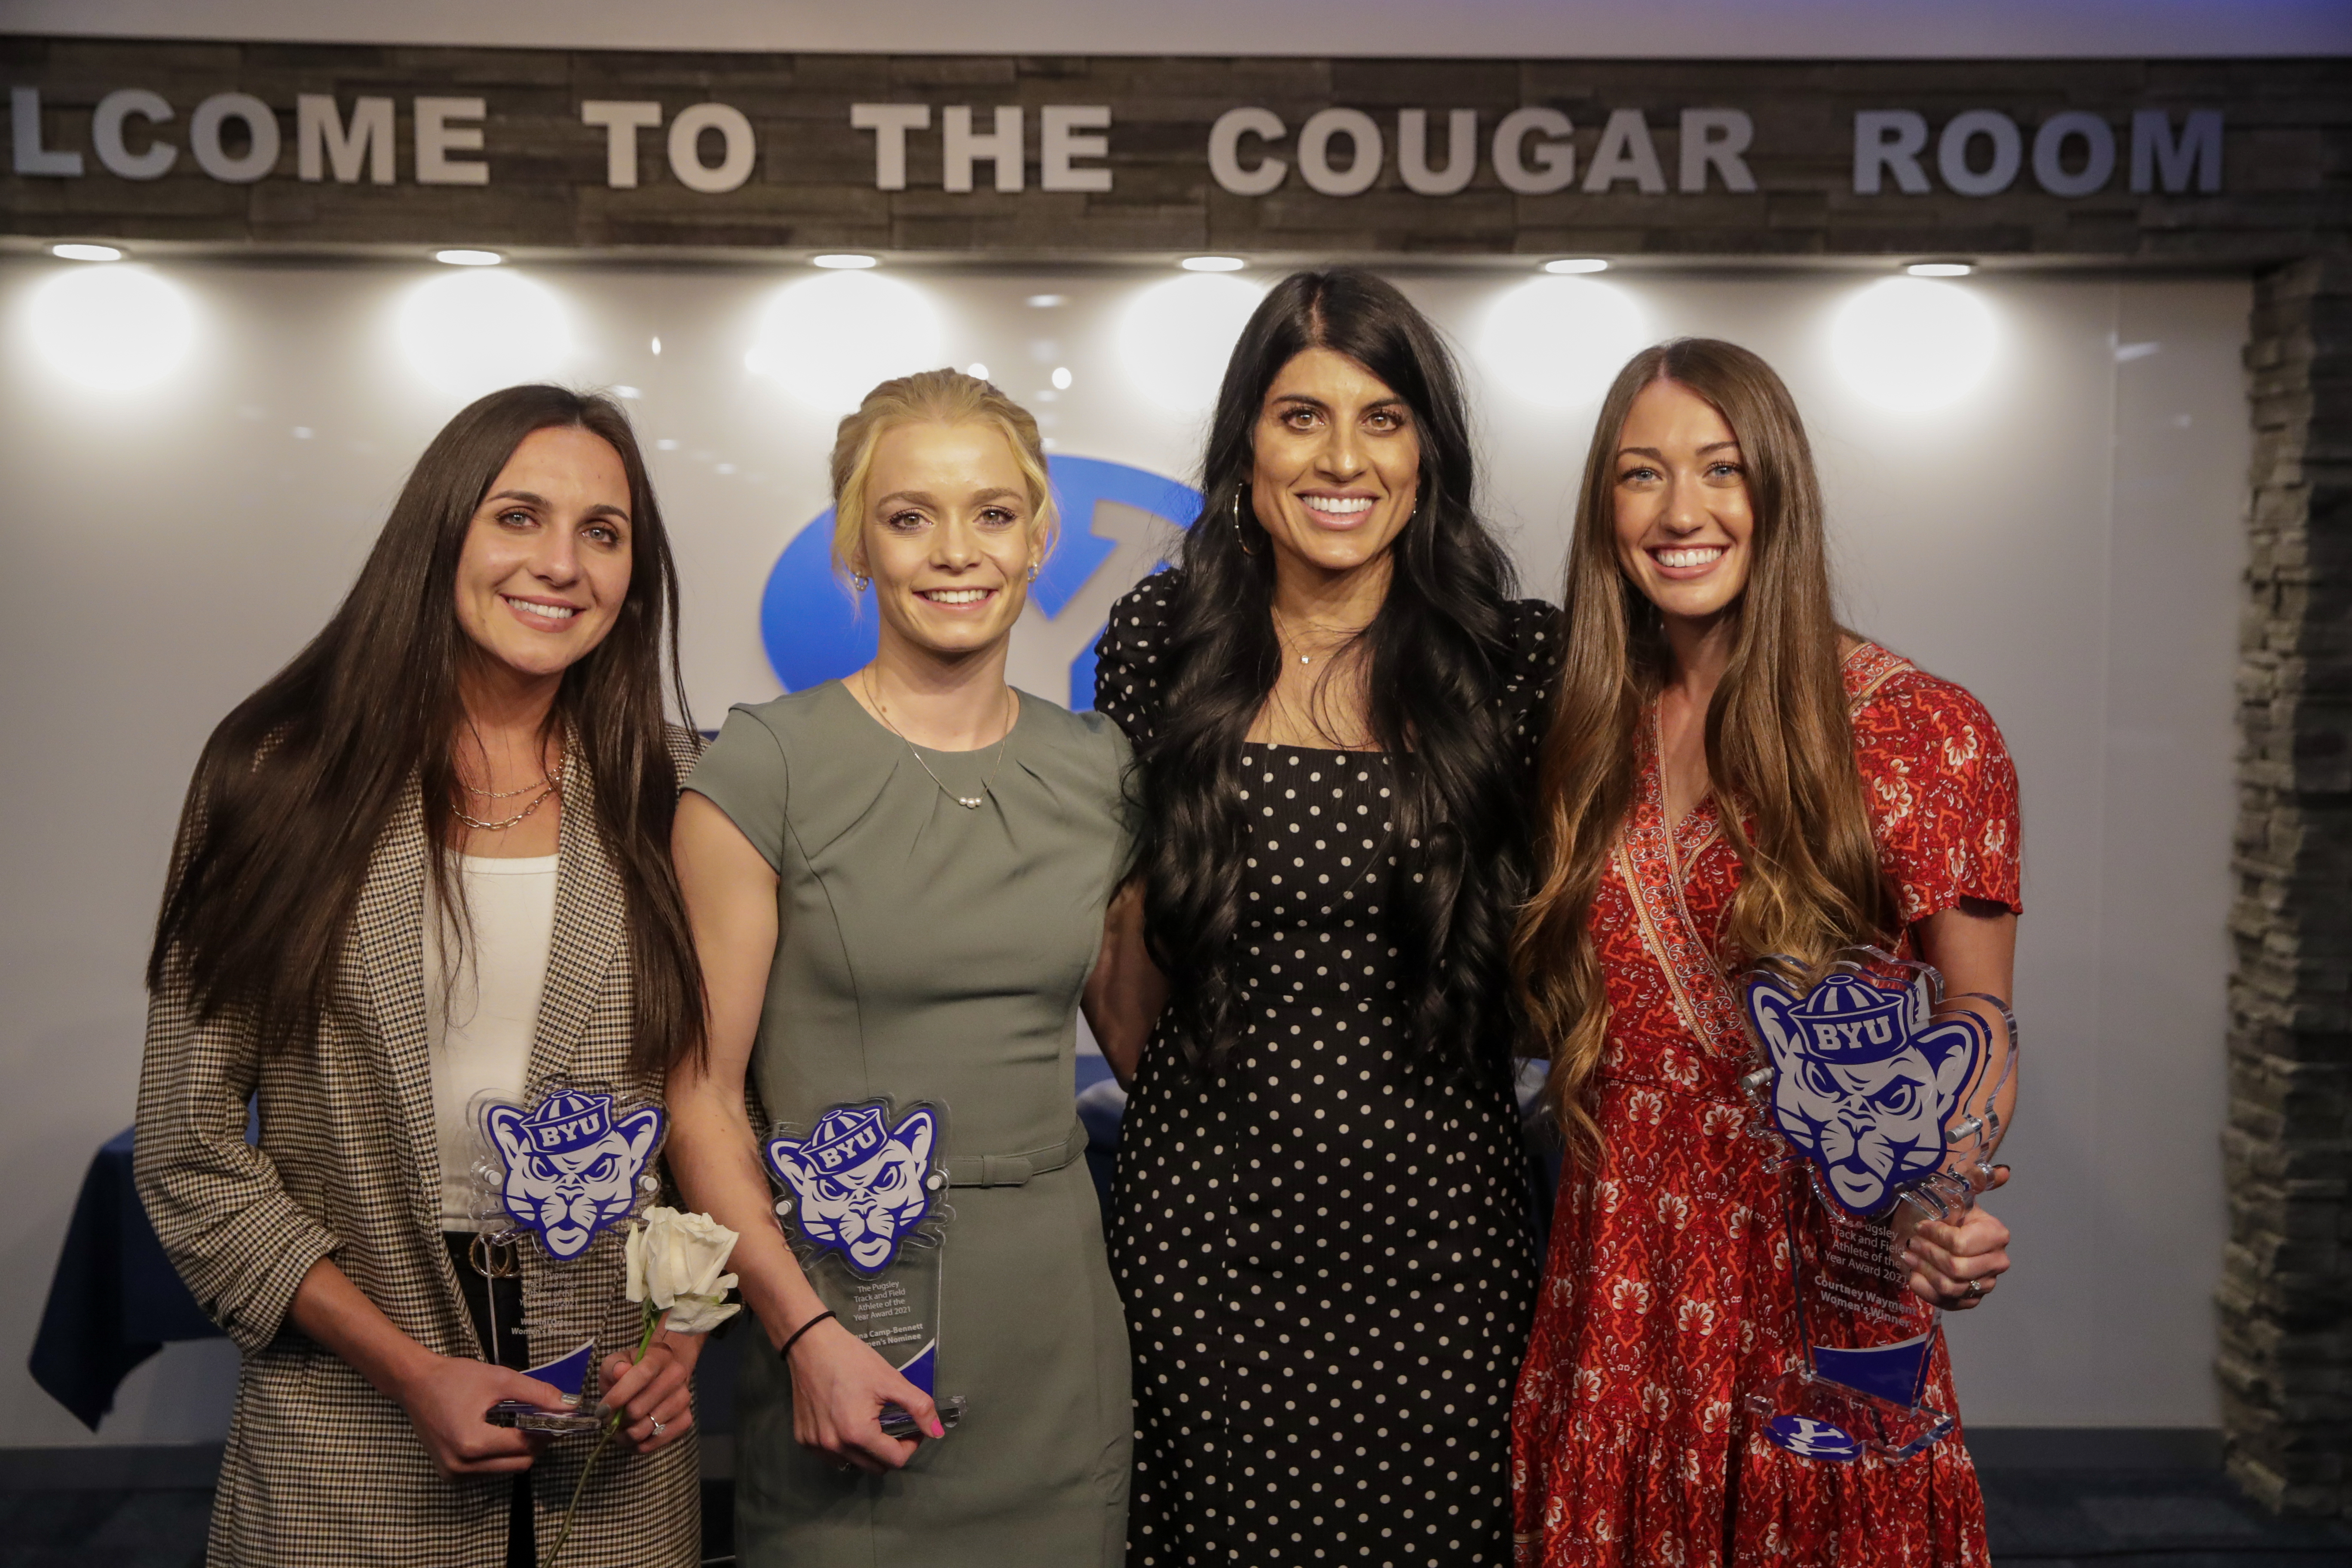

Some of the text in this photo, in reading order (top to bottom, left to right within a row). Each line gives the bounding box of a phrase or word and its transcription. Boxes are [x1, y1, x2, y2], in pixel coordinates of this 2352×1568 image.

[10, 86, 2223, 196] LCOME TO THE COUGAR ROOM
[1813, 1015, 1892, 1050] BYU
[539, 1113, 600, 1147] BYU
[818, 1126, 877, 1169] BYU
[1830, 1224, 1905, 1256] Track and Field
[1832, 1239, 1902, 1269] Athlete of the
[1825, 1250, 1907, 1284] Year Award 2021
[854, 1288, 906, 1303] Track and Field
[872, 1281, 900, 1290] Pugsley
[1814, 1275, 1917, 1316] Courtney Wayment
[858, 1302, 883, 1311] Athlete
[871, 1309, 893, 1319] Award
[894, 1306, 911, 1315] 2021
[1820, 1290, 1911, 1328] Women's Winner
[870, 1323, 923, 1337] Camp-Bennett
[888, 1333, 922, 1344] Nominee
